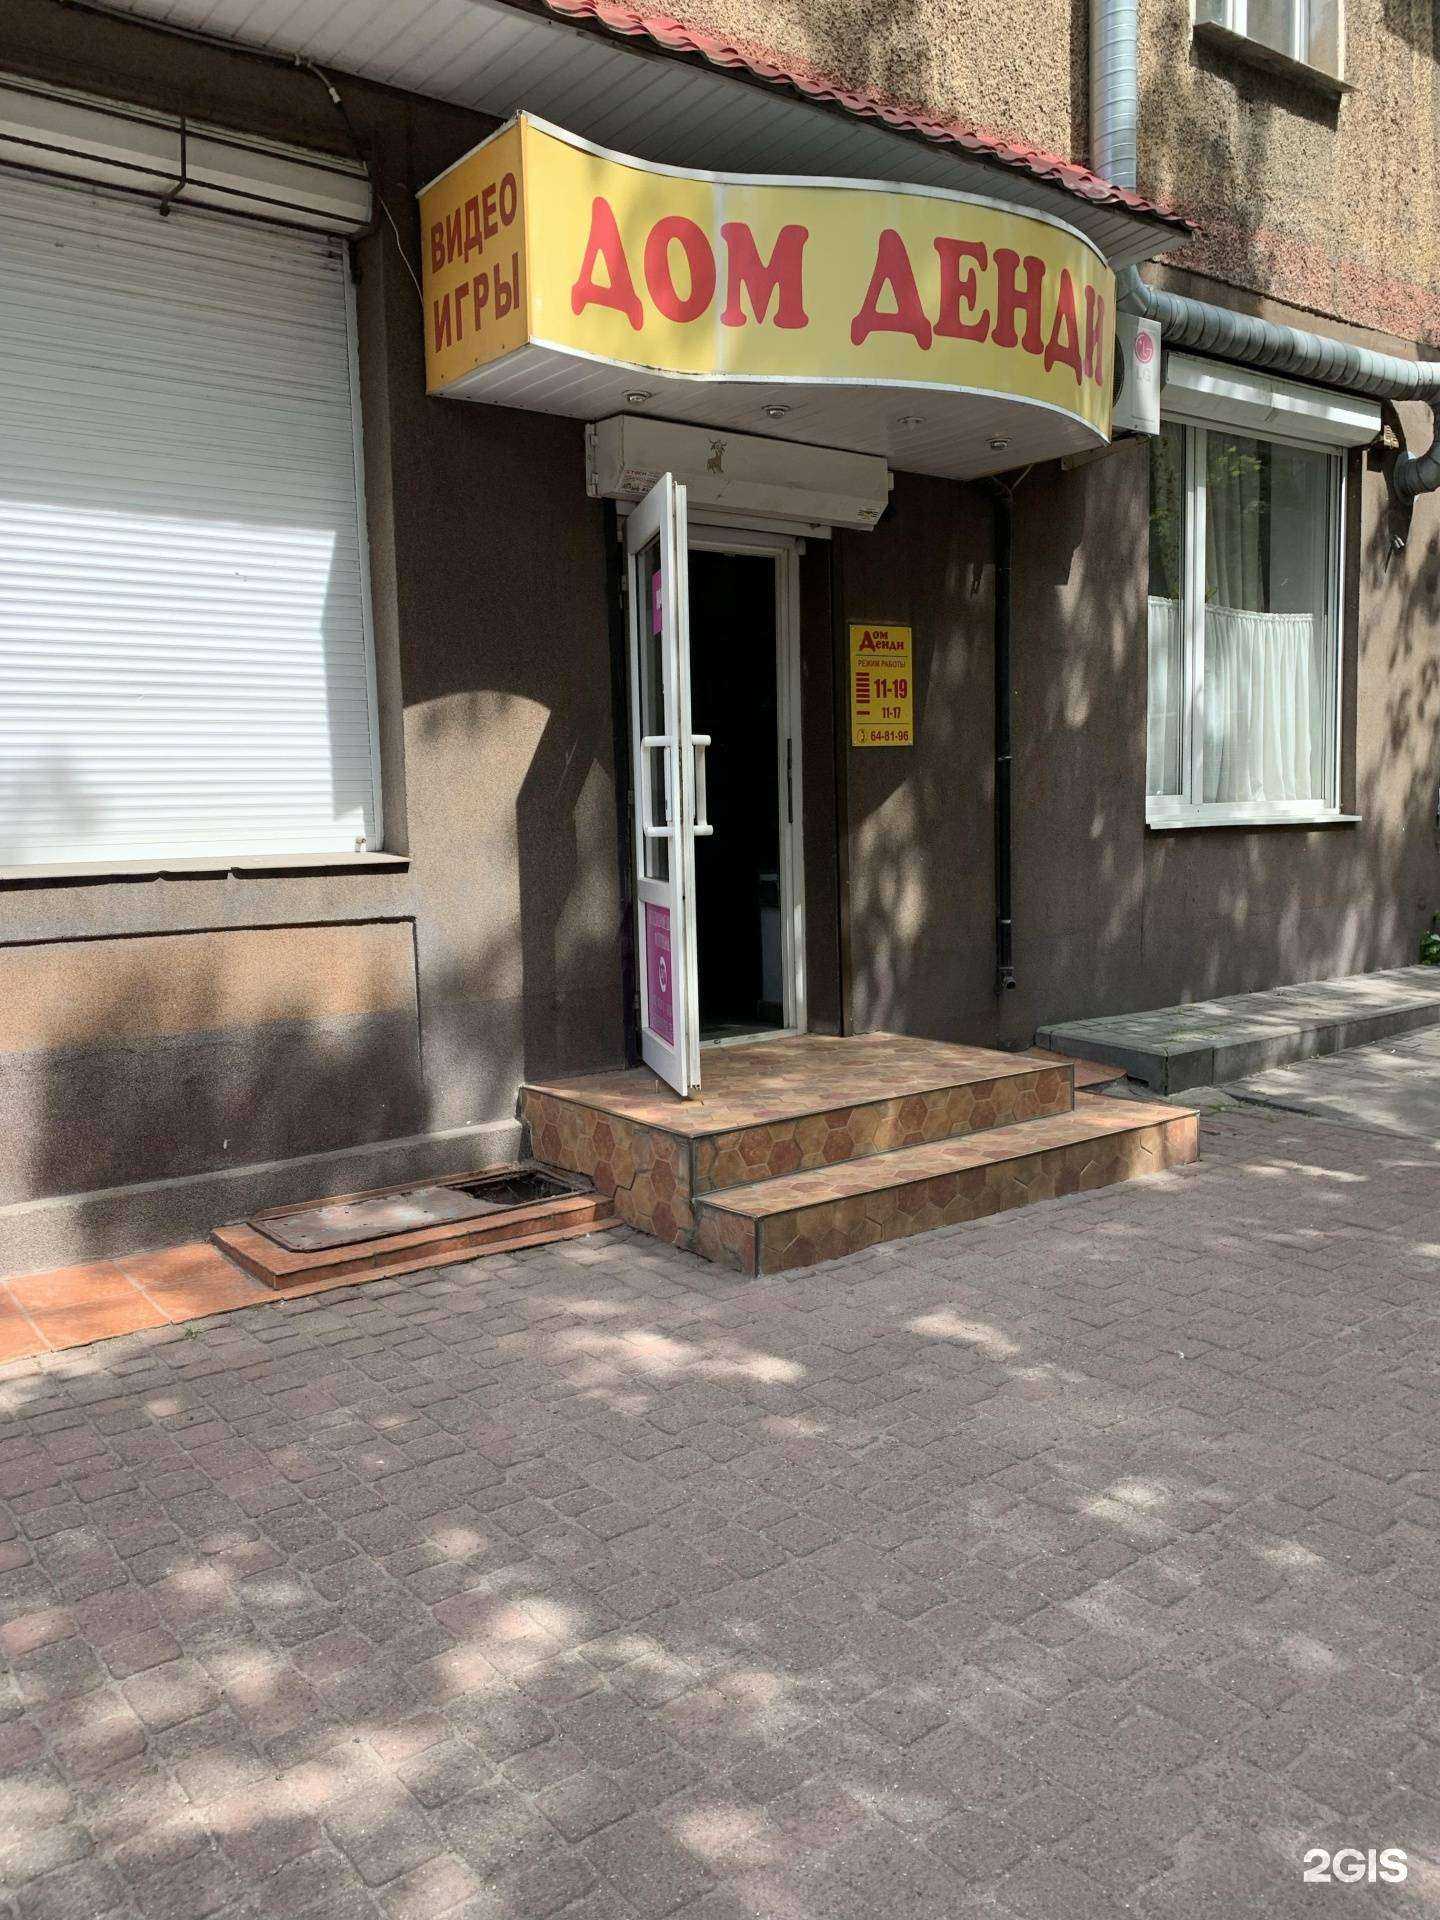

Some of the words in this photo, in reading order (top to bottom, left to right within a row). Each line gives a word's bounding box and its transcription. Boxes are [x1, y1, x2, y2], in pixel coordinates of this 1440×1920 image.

[431, 172, 518, 274] ВИДЕО
[433, 251, 520, 354] ИГРЫ
[571, 196, 809, 331] ДОМ
[850, 228, 1105, 386] ДЕНДИ
[1136, 367, 1152, 383] LG
[874, 678, 908, 699] 11-19
[882, 706, 901, 719] 11-17
